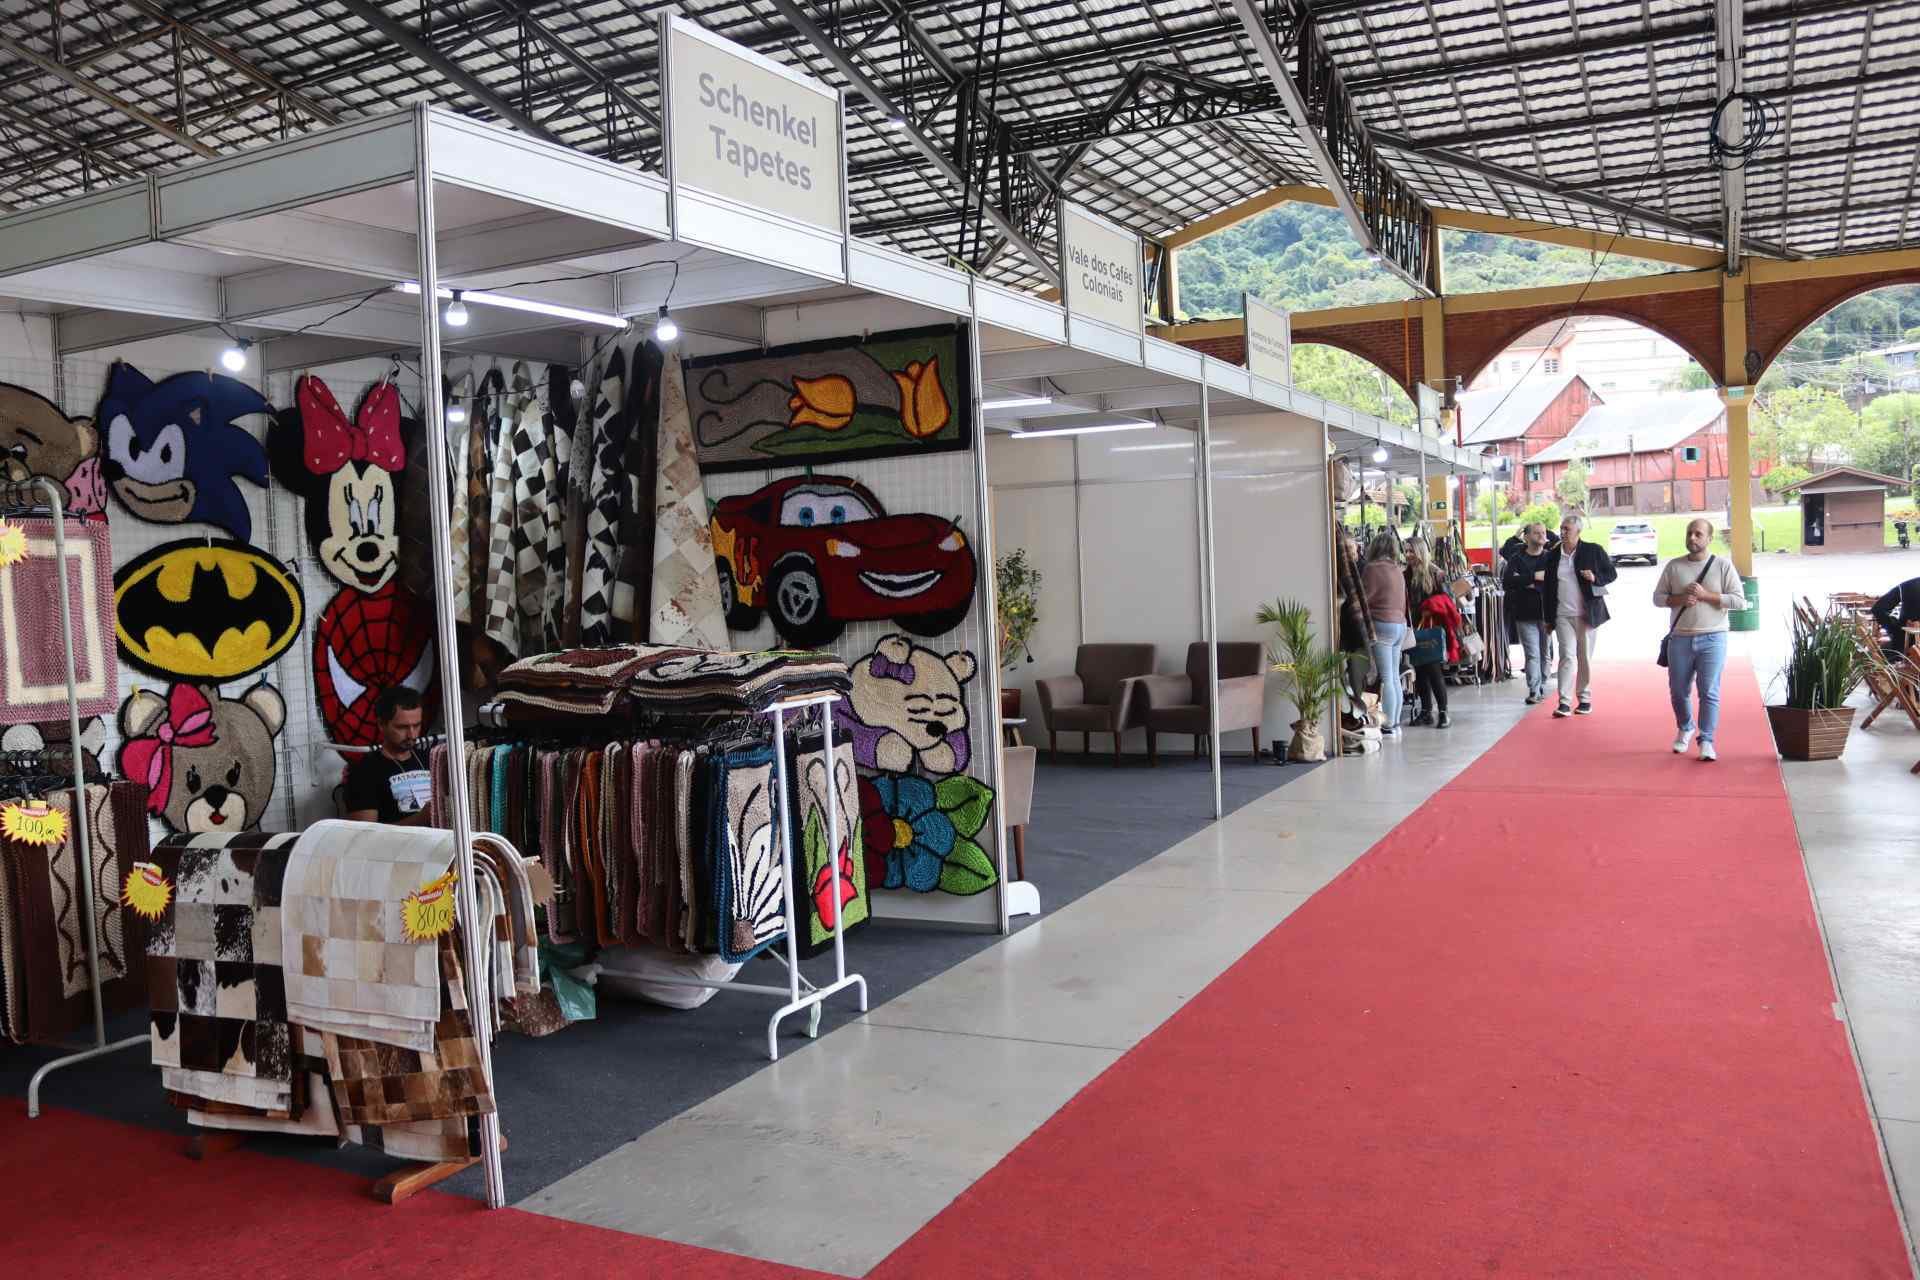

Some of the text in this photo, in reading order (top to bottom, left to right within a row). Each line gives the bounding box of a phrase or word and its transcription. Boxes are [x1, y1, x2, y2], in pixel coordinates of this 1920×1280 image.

[698, 72, 817, 149] Schenkel
[709, 124, 812, 191] Tapetes
[1068, 243, 1134, 286] Vale dos Cafés
[1082, 272, 1124, 303] Coloniais
